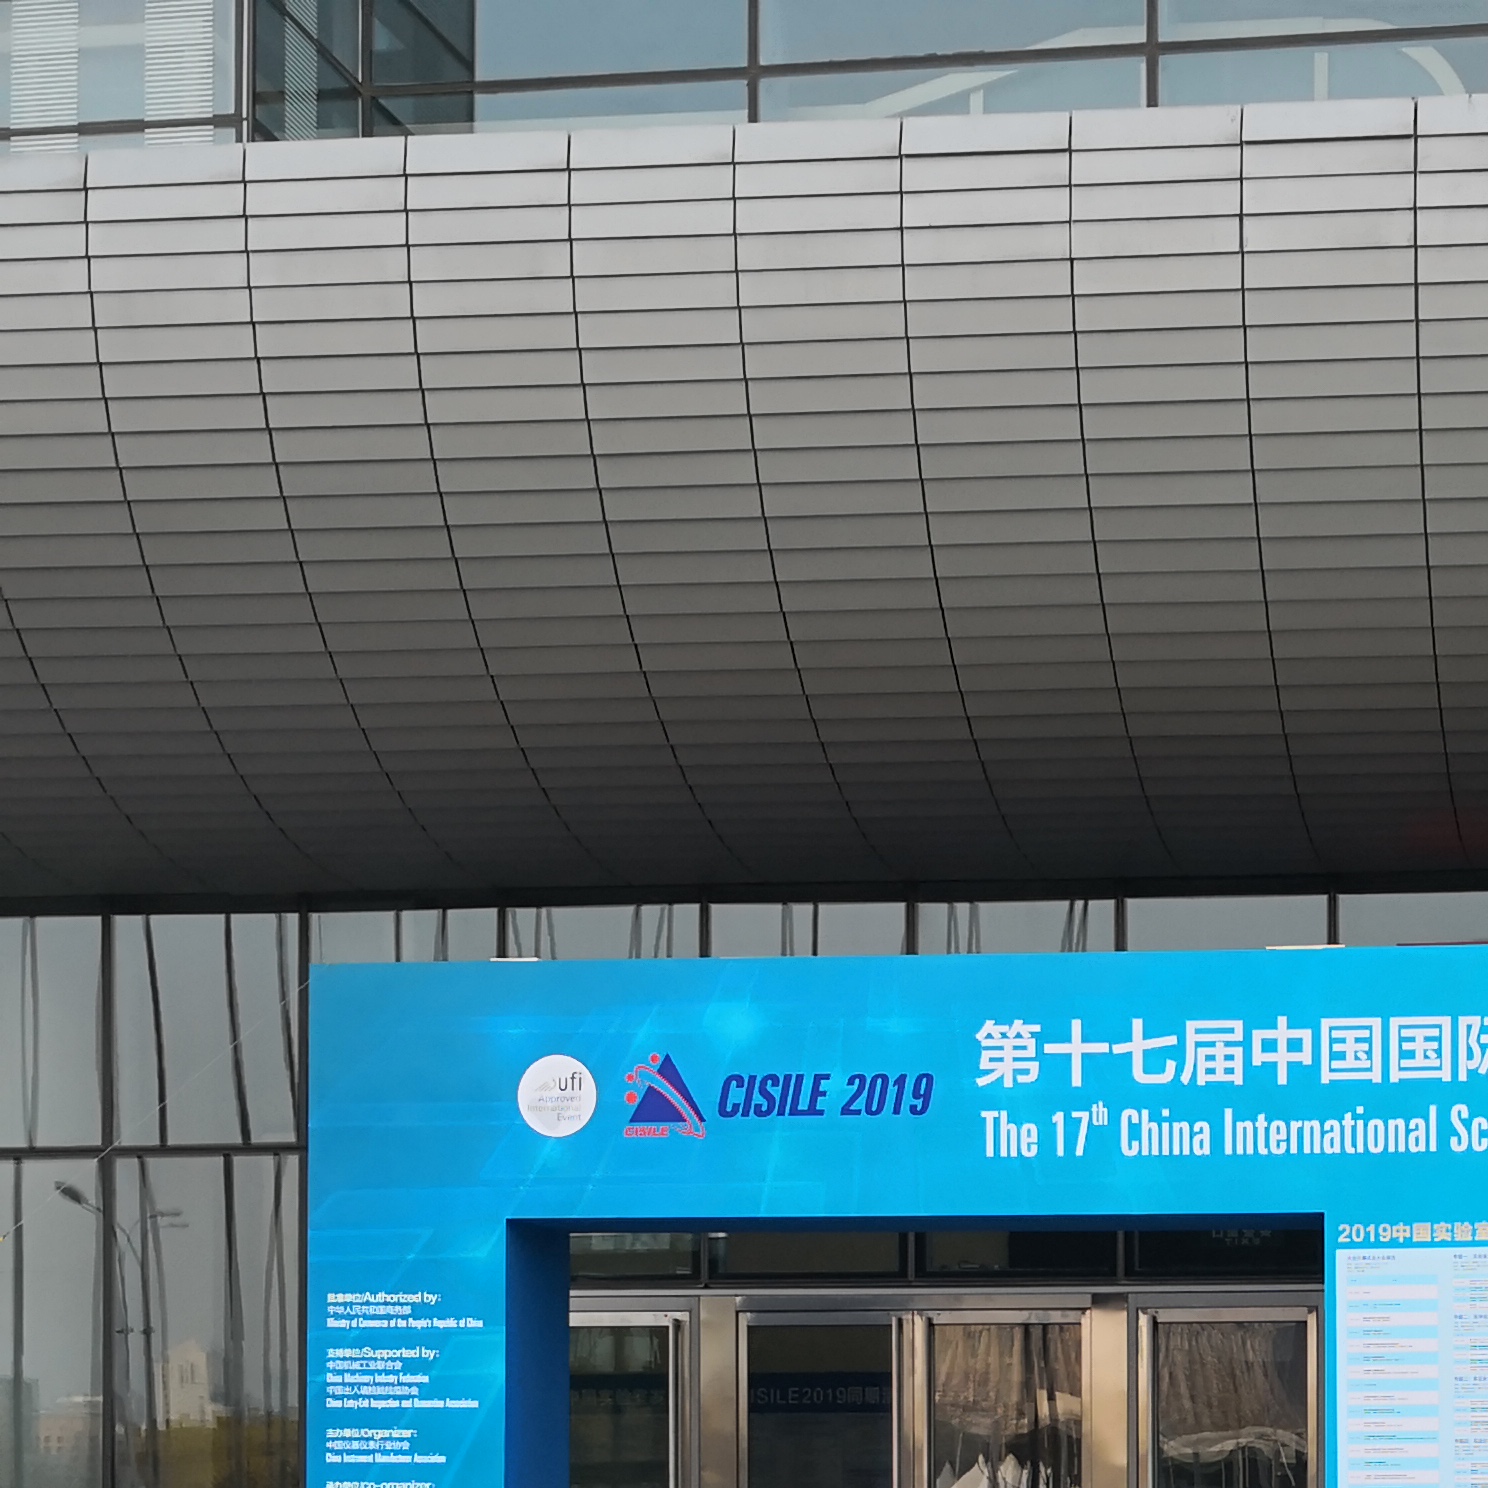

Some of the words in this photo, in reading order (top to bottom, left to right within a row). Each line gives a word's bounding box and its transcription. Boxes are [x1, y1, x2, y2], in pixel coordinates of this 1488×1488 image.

[558, 1072, 583, 1091] ufi
[537, 1095, 582, 1106] Approved
[717, 1073, 831, 1118] CISILE
[840, 1073, 934, 1117] 2019
[527, 1104, 581, 1113] International
[556, 1113, 582, 1122] Event
[624, 1125, 670, 1137] CISILE
[980, 1110, 1039, 1158] The
[1051, 1101, 1109, 1157] 17th
[1119, 1107, 1211, 1157] China
[1224, 1104, 1438, 1155] International
